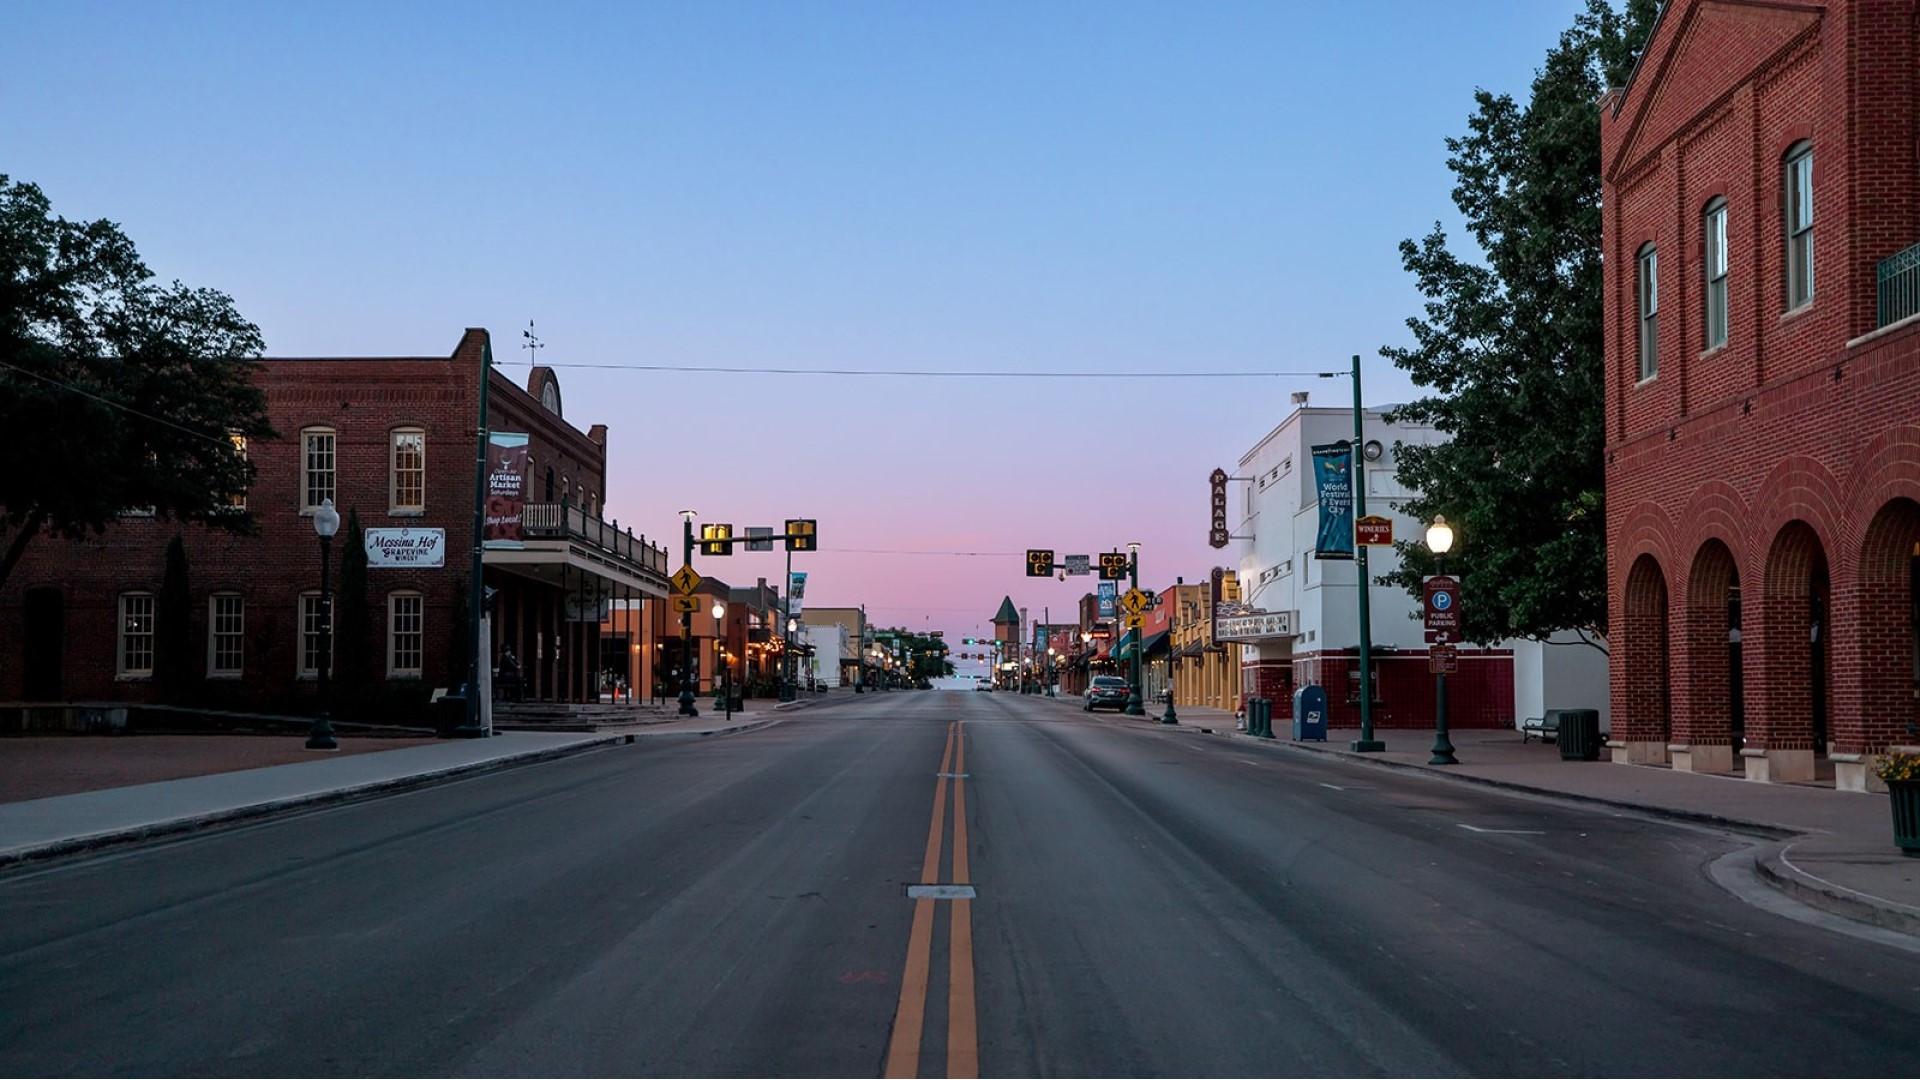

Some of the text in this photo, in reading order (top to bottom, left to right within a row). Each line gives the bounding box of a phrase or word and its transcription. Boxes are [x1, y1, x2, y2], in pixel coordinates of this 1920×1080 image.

[489, 473, 522, 482] Artisan
[490, 481, 521, 489] Market
[1322, 483, 1348, 491] World
[369, 536, 439, 550] Messina Hof
[382, 547, 429, 558] GRAPEVINE
[1430, 612, 1454, 620] PUBLIC
[1428, 619, 1457, 627] PARKING
